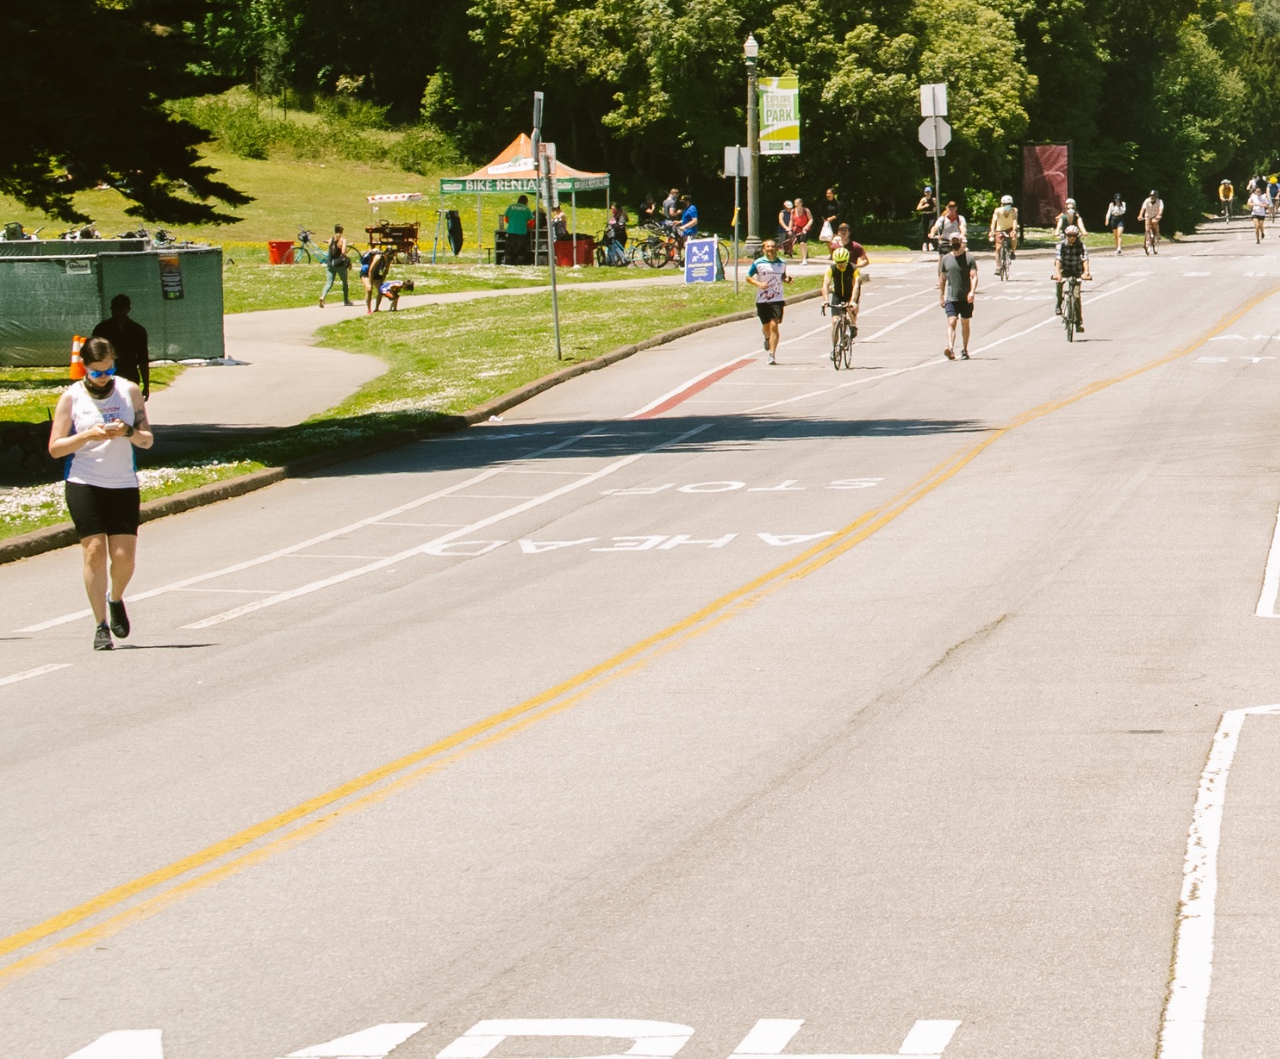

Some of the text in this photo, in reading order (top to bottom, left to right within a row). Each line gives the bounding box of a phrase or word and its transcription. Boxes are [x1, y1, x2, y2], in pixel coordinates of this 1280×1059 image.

[766, 109, 792, 122] PARK
[466, 180, 492, 191] BIKE
[496, 180, 542, 191] RENTA
